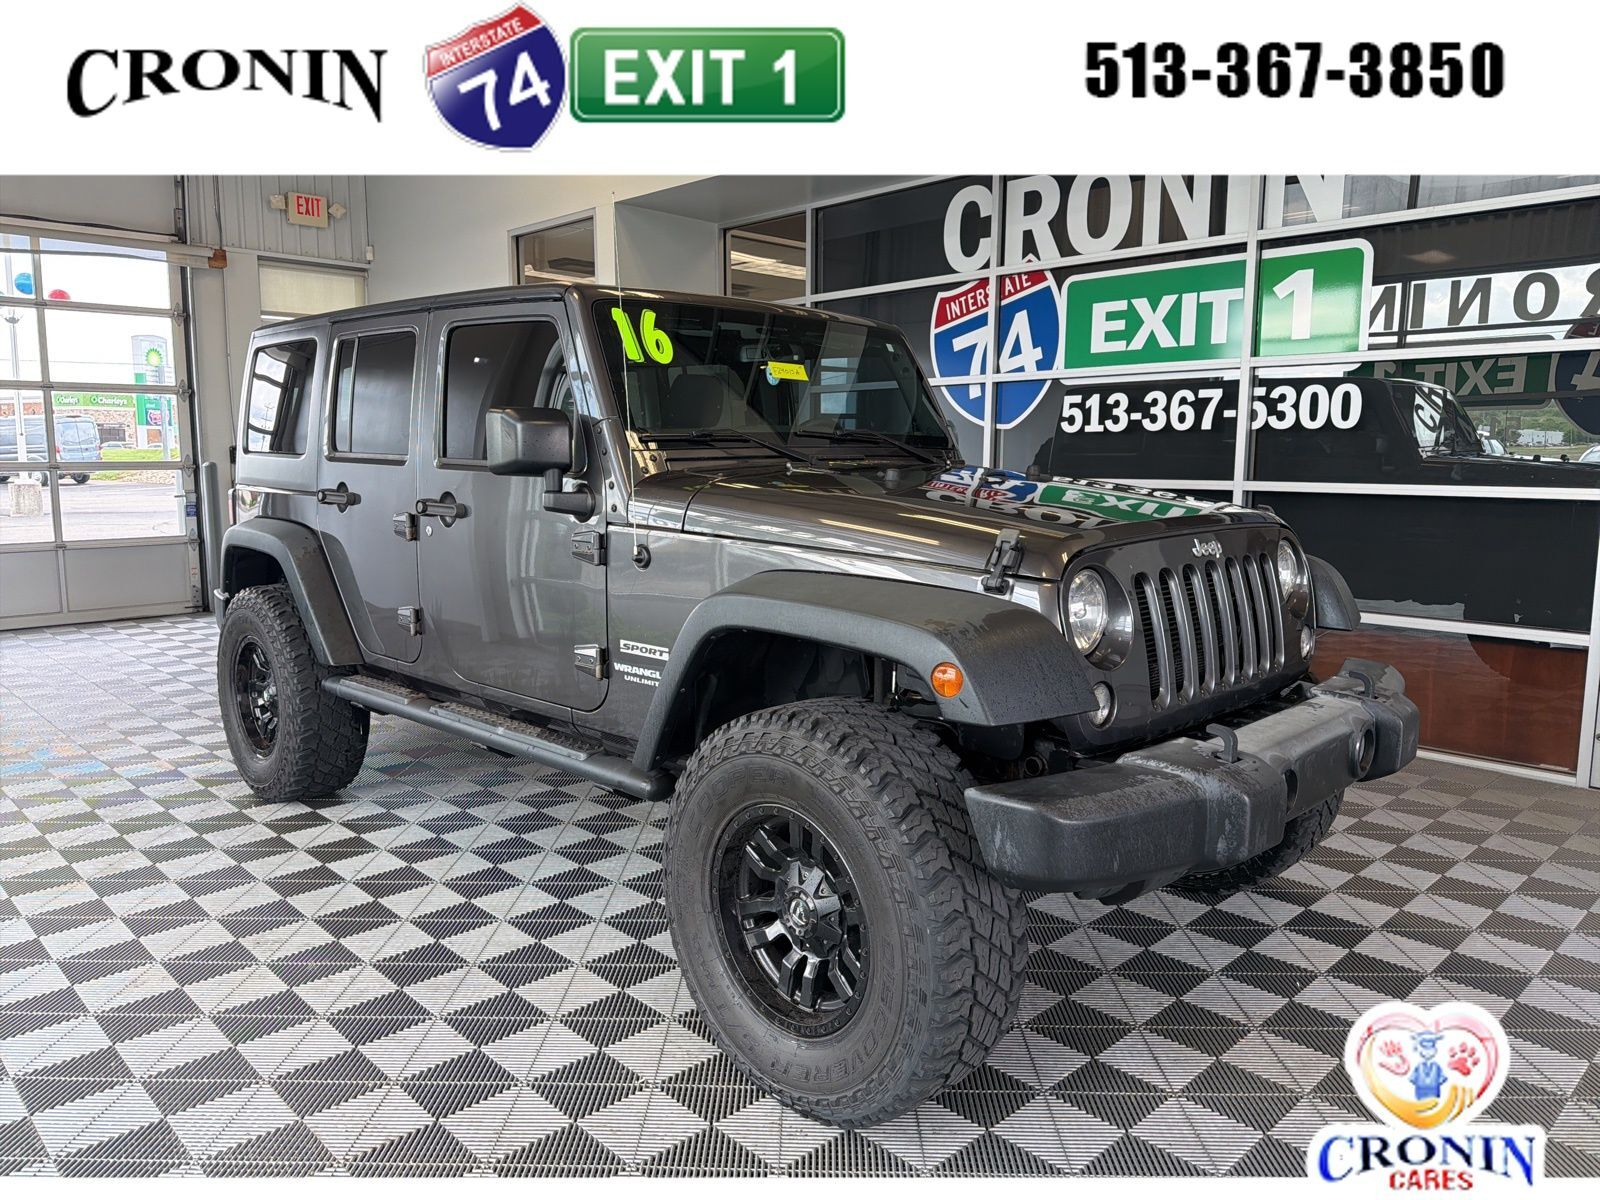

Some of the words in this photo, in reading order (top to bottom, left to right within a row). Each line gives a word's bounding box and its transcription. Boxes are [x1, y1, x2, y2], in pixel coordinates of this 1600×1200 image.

[296, 195, 321, 218] EXIT
[943, 174, 1346, 273] CRONIN
[1090, 288, 1244, 353] EXIT
[1272, 268, 1314, 340] 1
[611, 307, 674, 365] 16
[952, 309, 1043, 400] 74
[1060, 383, 1363, 434] 513-367-5300
[1192, 538, 1223, 559] Jeep
[621, 642, 669, 658] SPORT
[613, 662, 662, 679] WRANGL
[624, 675, 660, 687] UNLIMIT
